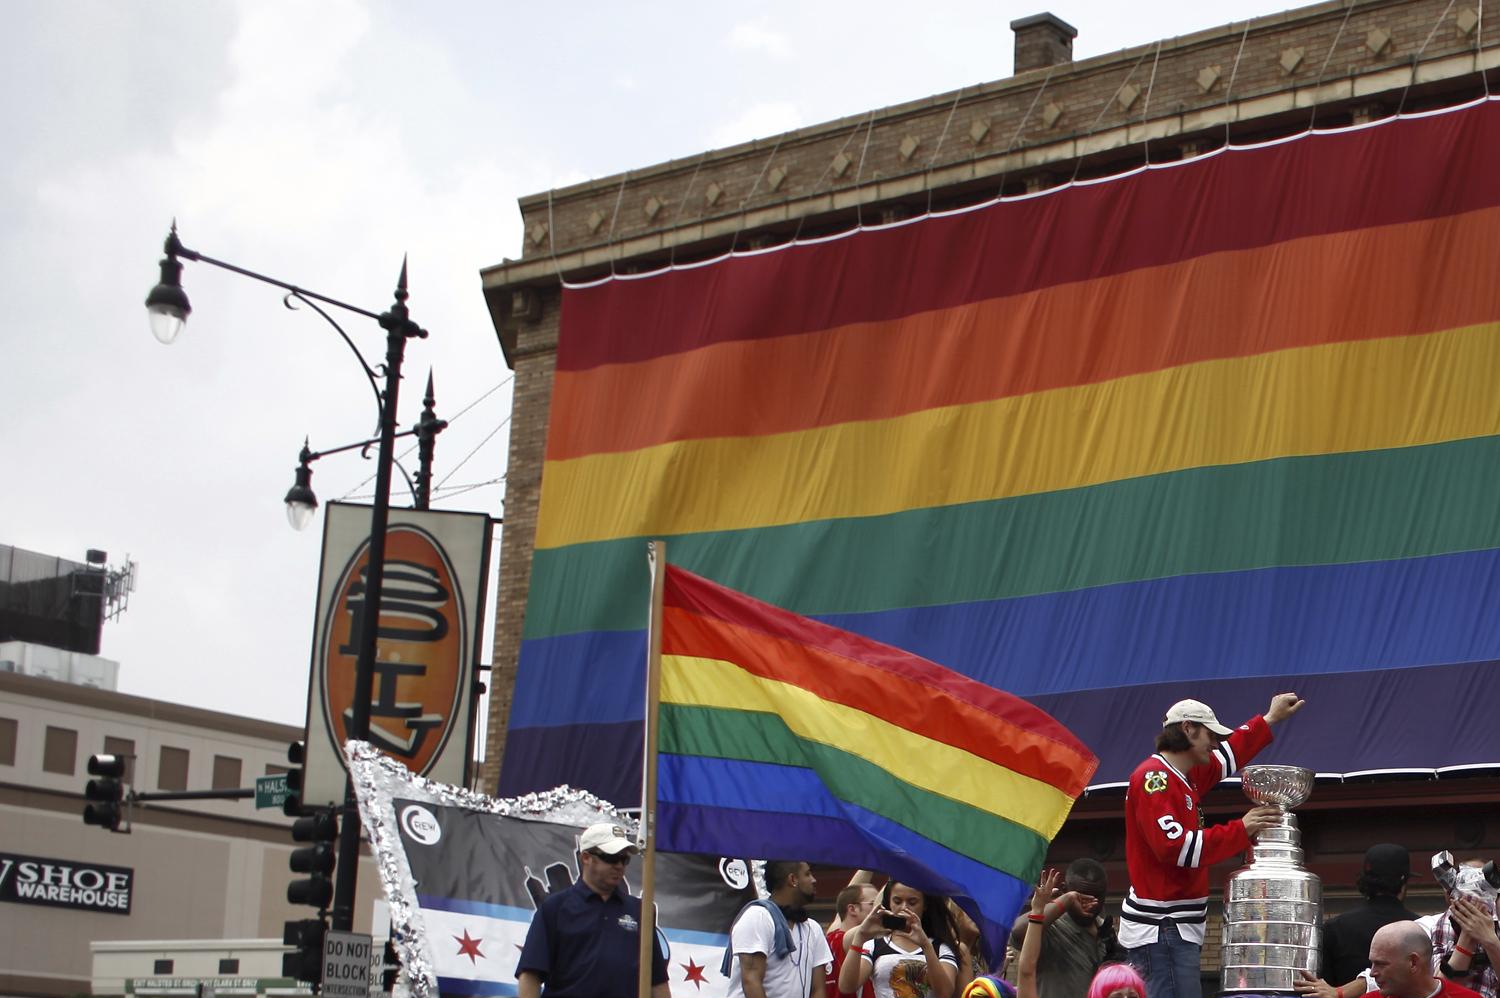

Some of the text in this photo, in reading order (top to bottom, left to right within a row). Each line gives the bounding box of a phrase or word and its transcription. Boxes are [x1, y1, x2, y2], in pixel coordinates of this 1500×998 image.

[264, 778, 288, 793] HALS
[1157, 814, 1184, 840] 5
[17, 862, 129, 893] SHOE
[17, 882, 128, 909] WAREHOUSE
[327, 940, 370, 959] DO NOT
[326, 962, 367, 981] BLOCK
[323, 983, 366, 996] INTERSECTION
